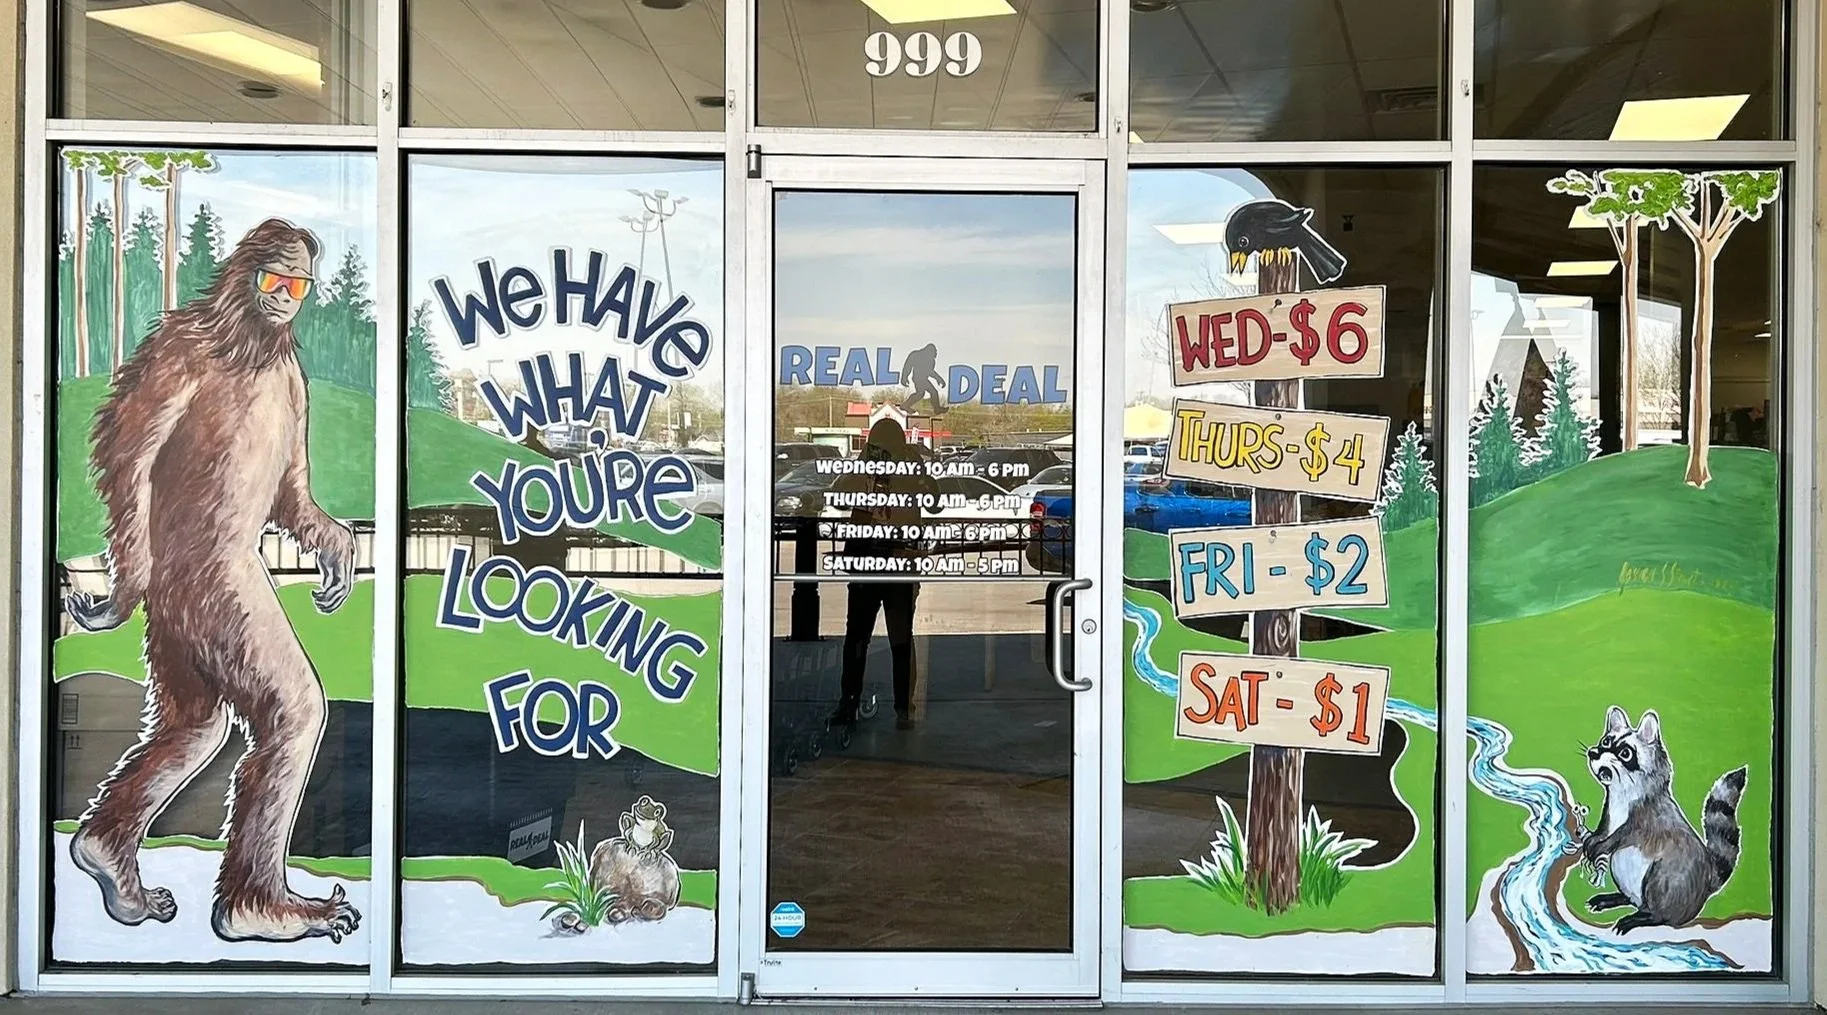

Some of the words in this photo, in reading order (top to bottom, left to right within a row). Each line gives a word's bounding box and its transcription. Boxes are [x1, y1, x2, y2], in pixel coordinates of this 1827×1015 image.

[864, 31, 982, 77] 999
[479, 352, 668, 437] WHAT
[779, 344, 901, 386] REAL
[947, 363, 1068, 405] DEAL
[924, 461, 943, 476] 10
[988, 462, 999, 477] 6
[823, 491, 913, 507] THURSDAY:
[915, 493, 935, 508] 10
[979, 494, 991, 509] 6
[837, 524, 898, 539] FRIDAY:
[901, 525, 921, 539] 10
[965, 526, 977, 541] 6
[822, 555, 912, 571] SATURDAY:
[913, 557, 934, 572] 10
[978, 558, 989, 573] 5
[1178, 541, 1255, 603] FRI
[1269, 565, 1287, 576] -
[1304, 531, 1369, 596] $2
[441, 547, 705, 700] LOOKING
[488, 672, 621, 757] FOR
[1183, 662, 1269, 732] SAT
[1276, 698, 1293, 710] -
[1310, 672, 1371, 745] $1
